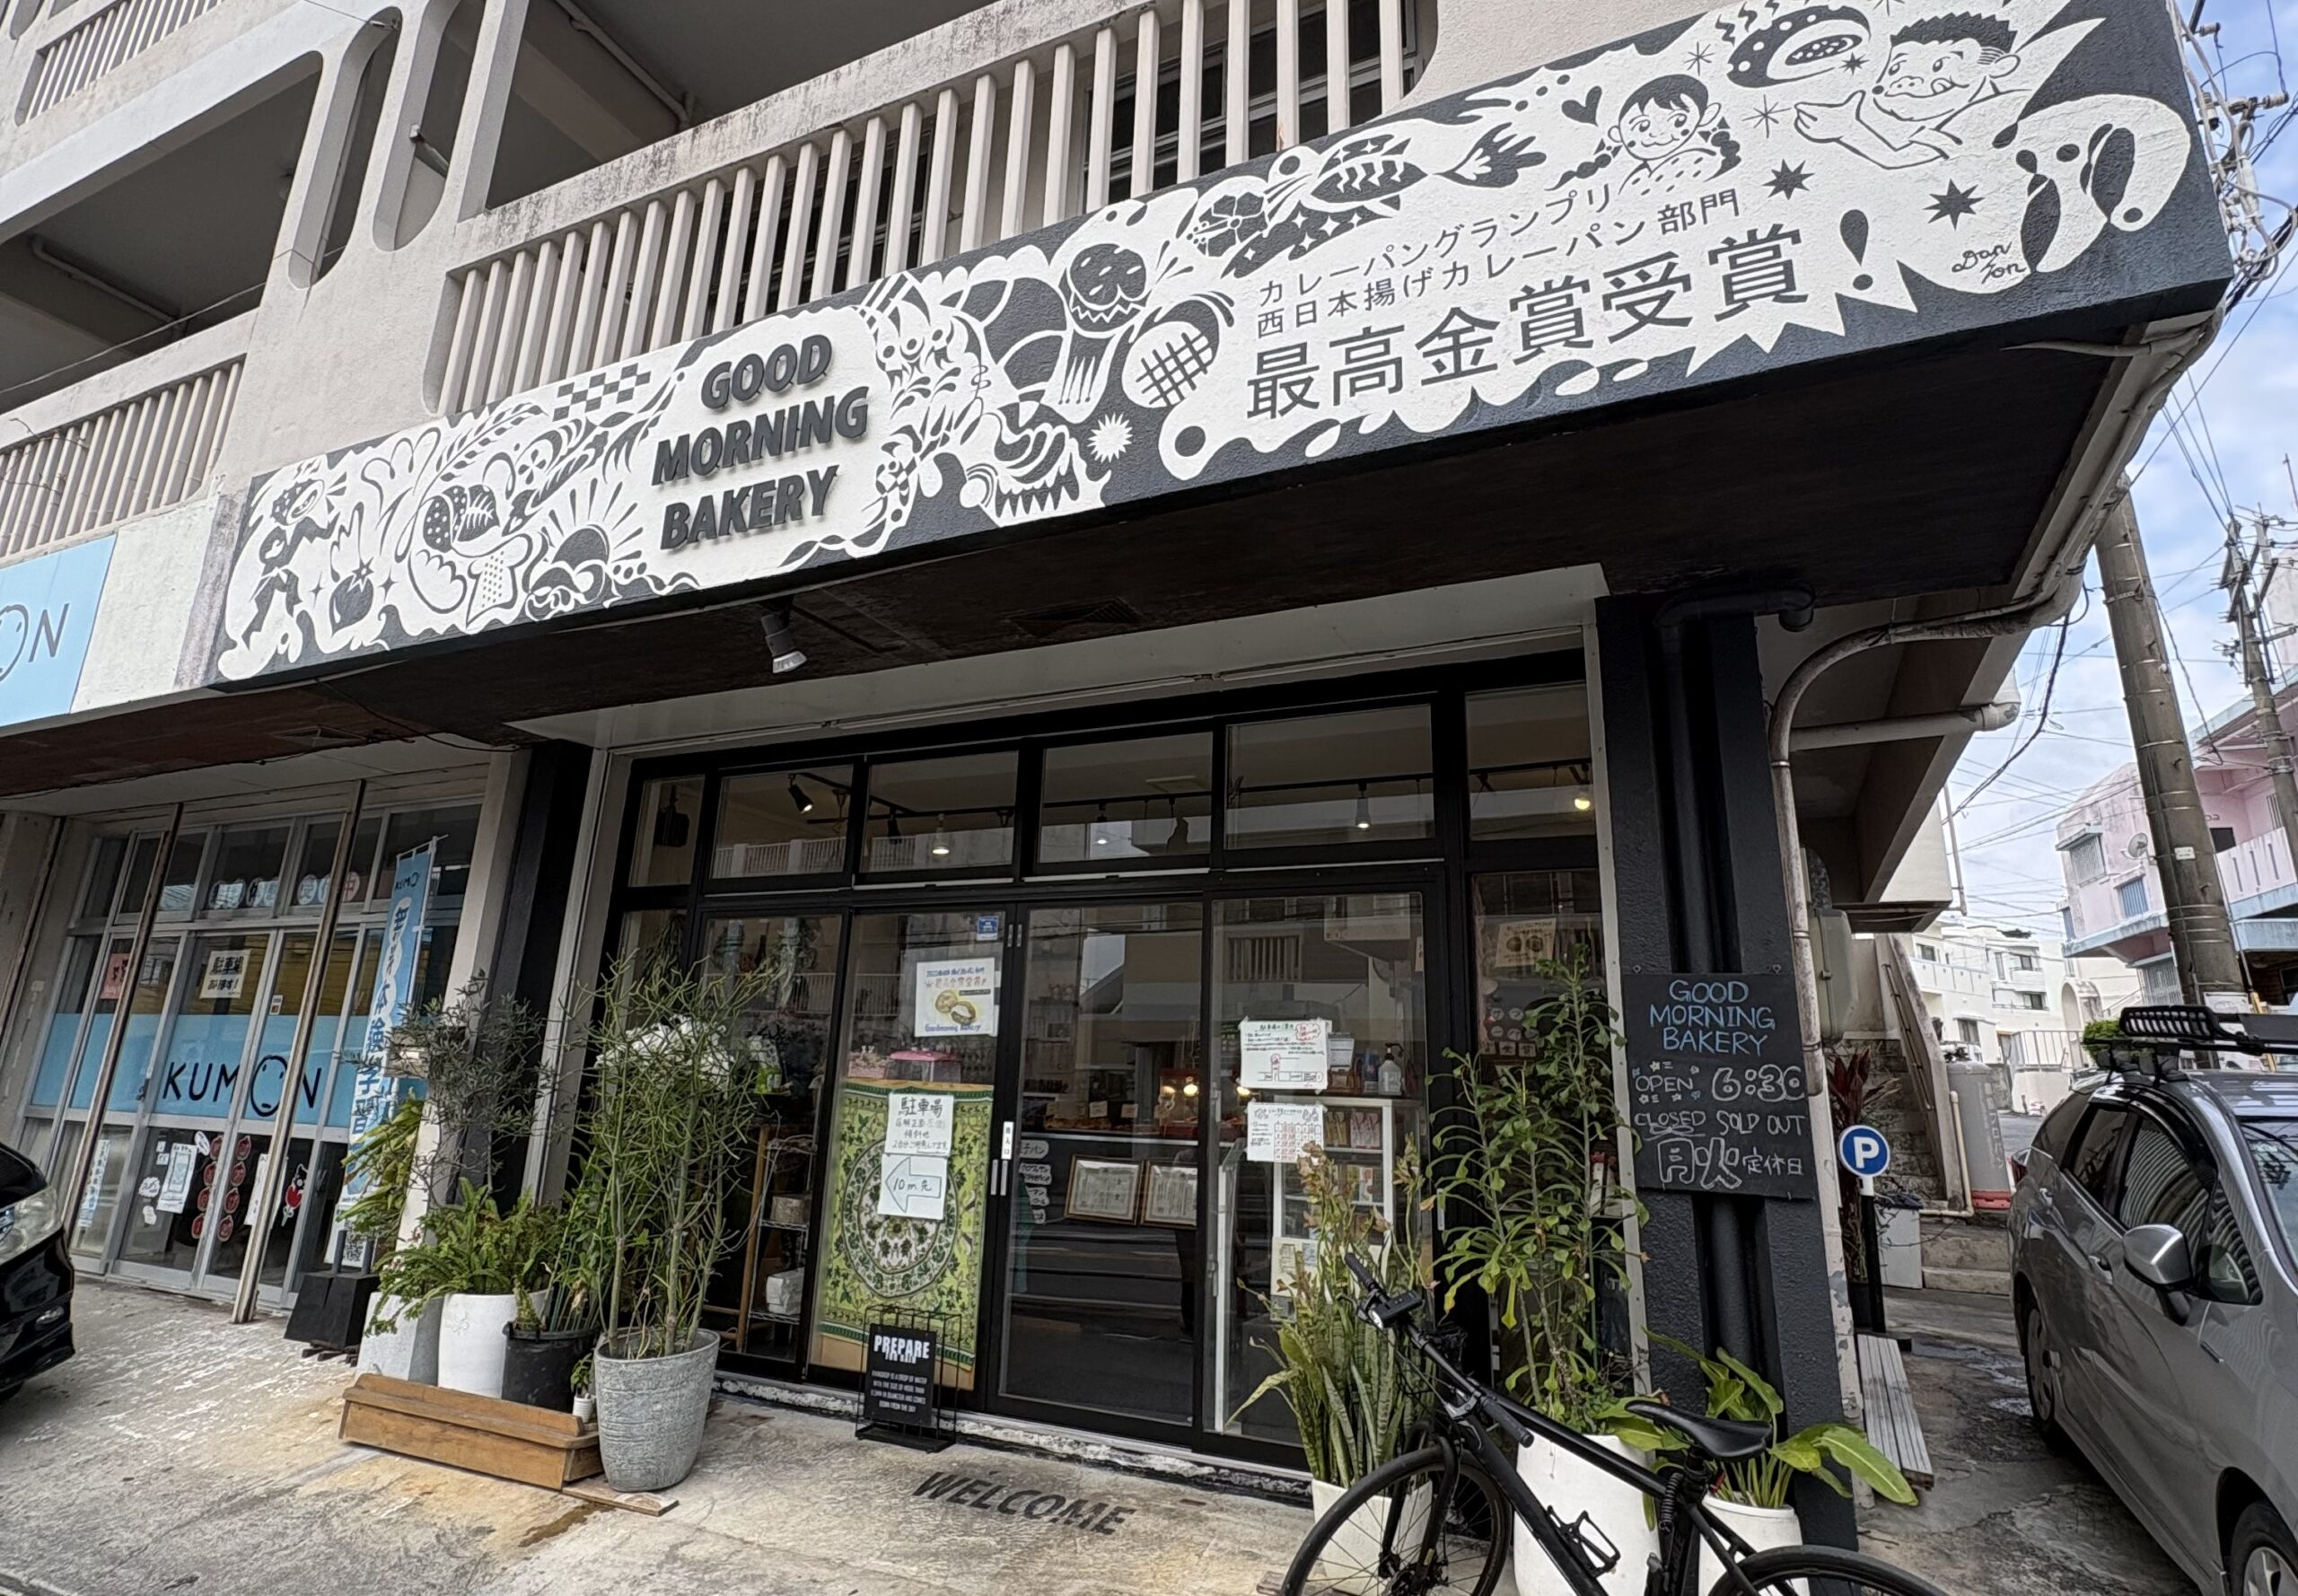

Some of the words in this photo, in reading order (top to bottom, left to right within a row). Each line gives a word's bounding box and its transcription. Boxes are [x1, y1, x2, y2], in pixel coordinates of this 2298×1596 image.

[1259, 183, 1610, 307] カレーパングランプリ
[700, 334, 833, 410] GOOD
[651, 386, 870, 487] MORNING
[660, 464, 840, 550] BAKERY
[1669, 979, 1749, 1004] GOOD
[1649, 1004, 1776, 1030] MORNING
[1662, 1026, 1768, 1057] BAKERY
[162, 1055, 323, 1118] KUMON
[1635, 1074, 1695, 1093] OPEN
[898, 1096, 943, 1119] 駐車場
[1634, 1110, 1706, 1127] CLOSED
[1715, 1109, 1760, 1136] SOLD
[1767, 1115, 1806, 1136] OUT
[1853, 1136, 1880, 1170] P
[873, 1335, 931, 1359] PREPARE
[911, 1470, 1138, 1536] WELCOME
